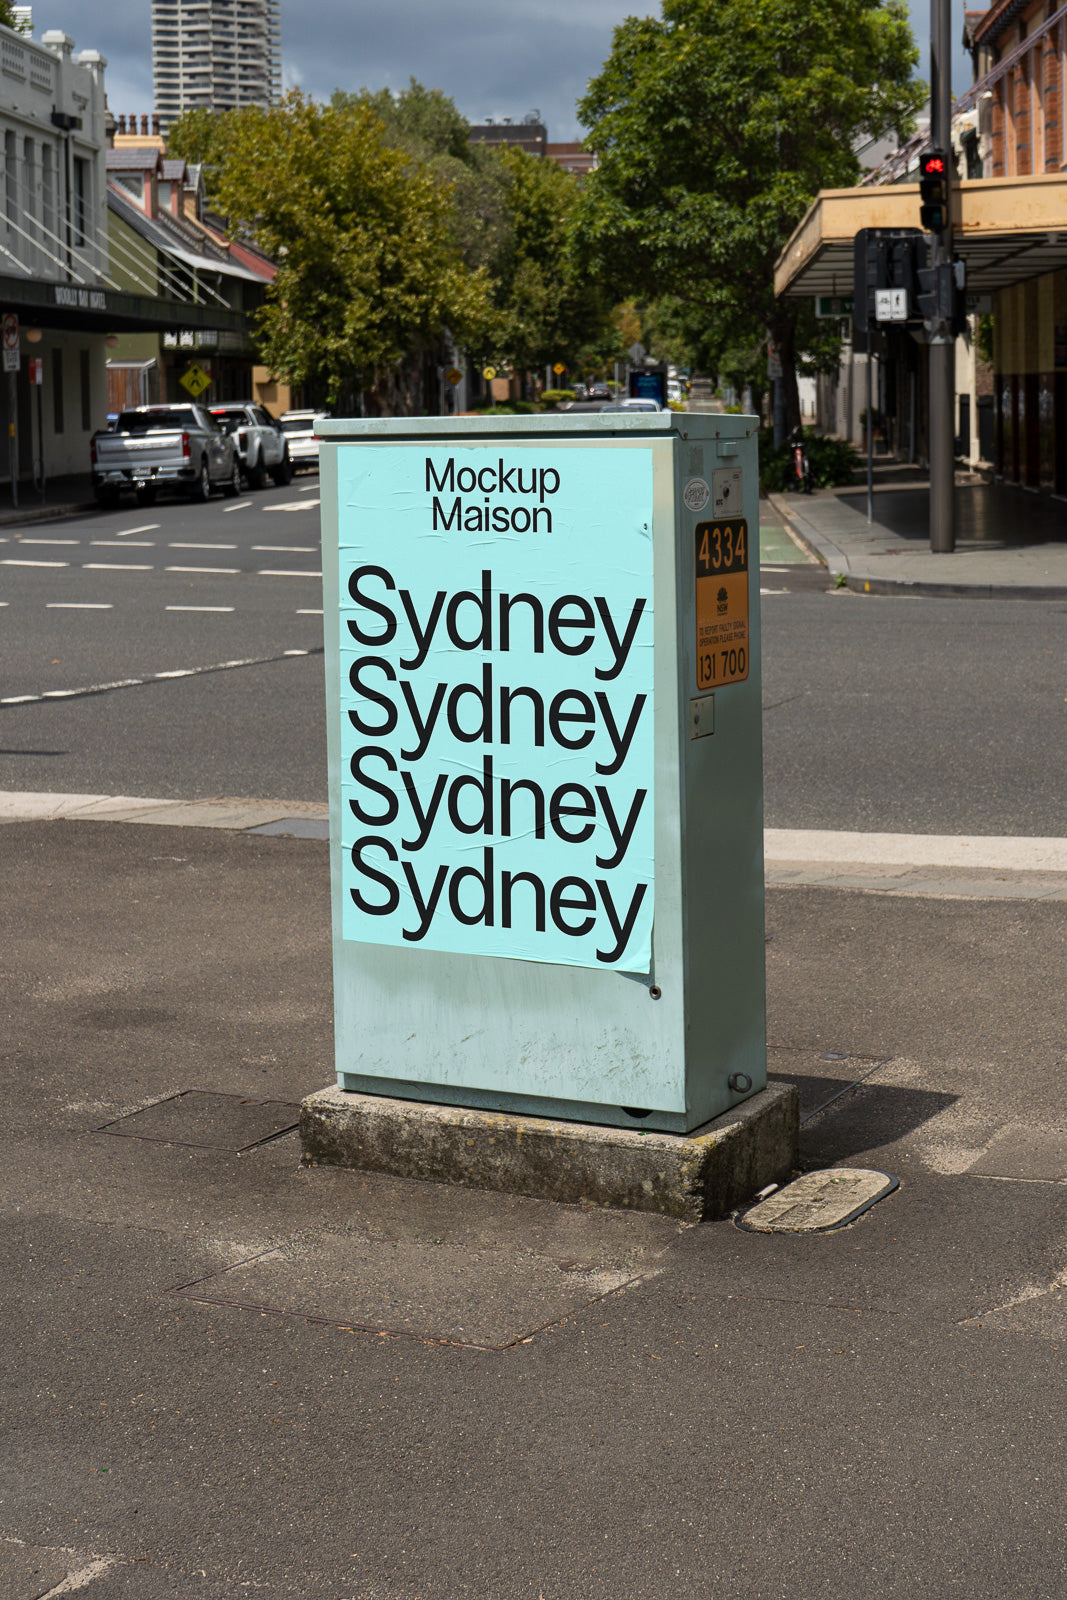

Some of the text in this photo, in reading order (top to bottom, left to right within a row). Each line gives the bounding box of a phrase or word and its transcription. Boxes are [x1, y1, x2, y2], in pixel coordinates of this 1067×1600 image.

[426, 458, 560, 503] Mockup
[433, 497, 551, 533] Maison
[699, 525, 745, 569] 4334
[347, 565, 647, 680] Sydney
[699, 620, 746, 636] TO REPORT FAULTY SIGNAL
[717, 603, 728, 612] NSW
[699, 630, 746, 647] OPERATION PLEASE PHONE
[700, 647, 745, 682] 131 700
[348, 656, 647, 775] Sydney
[349, 746, 647, 869] Sydney
[350, 836, 647, 963] Sydney
